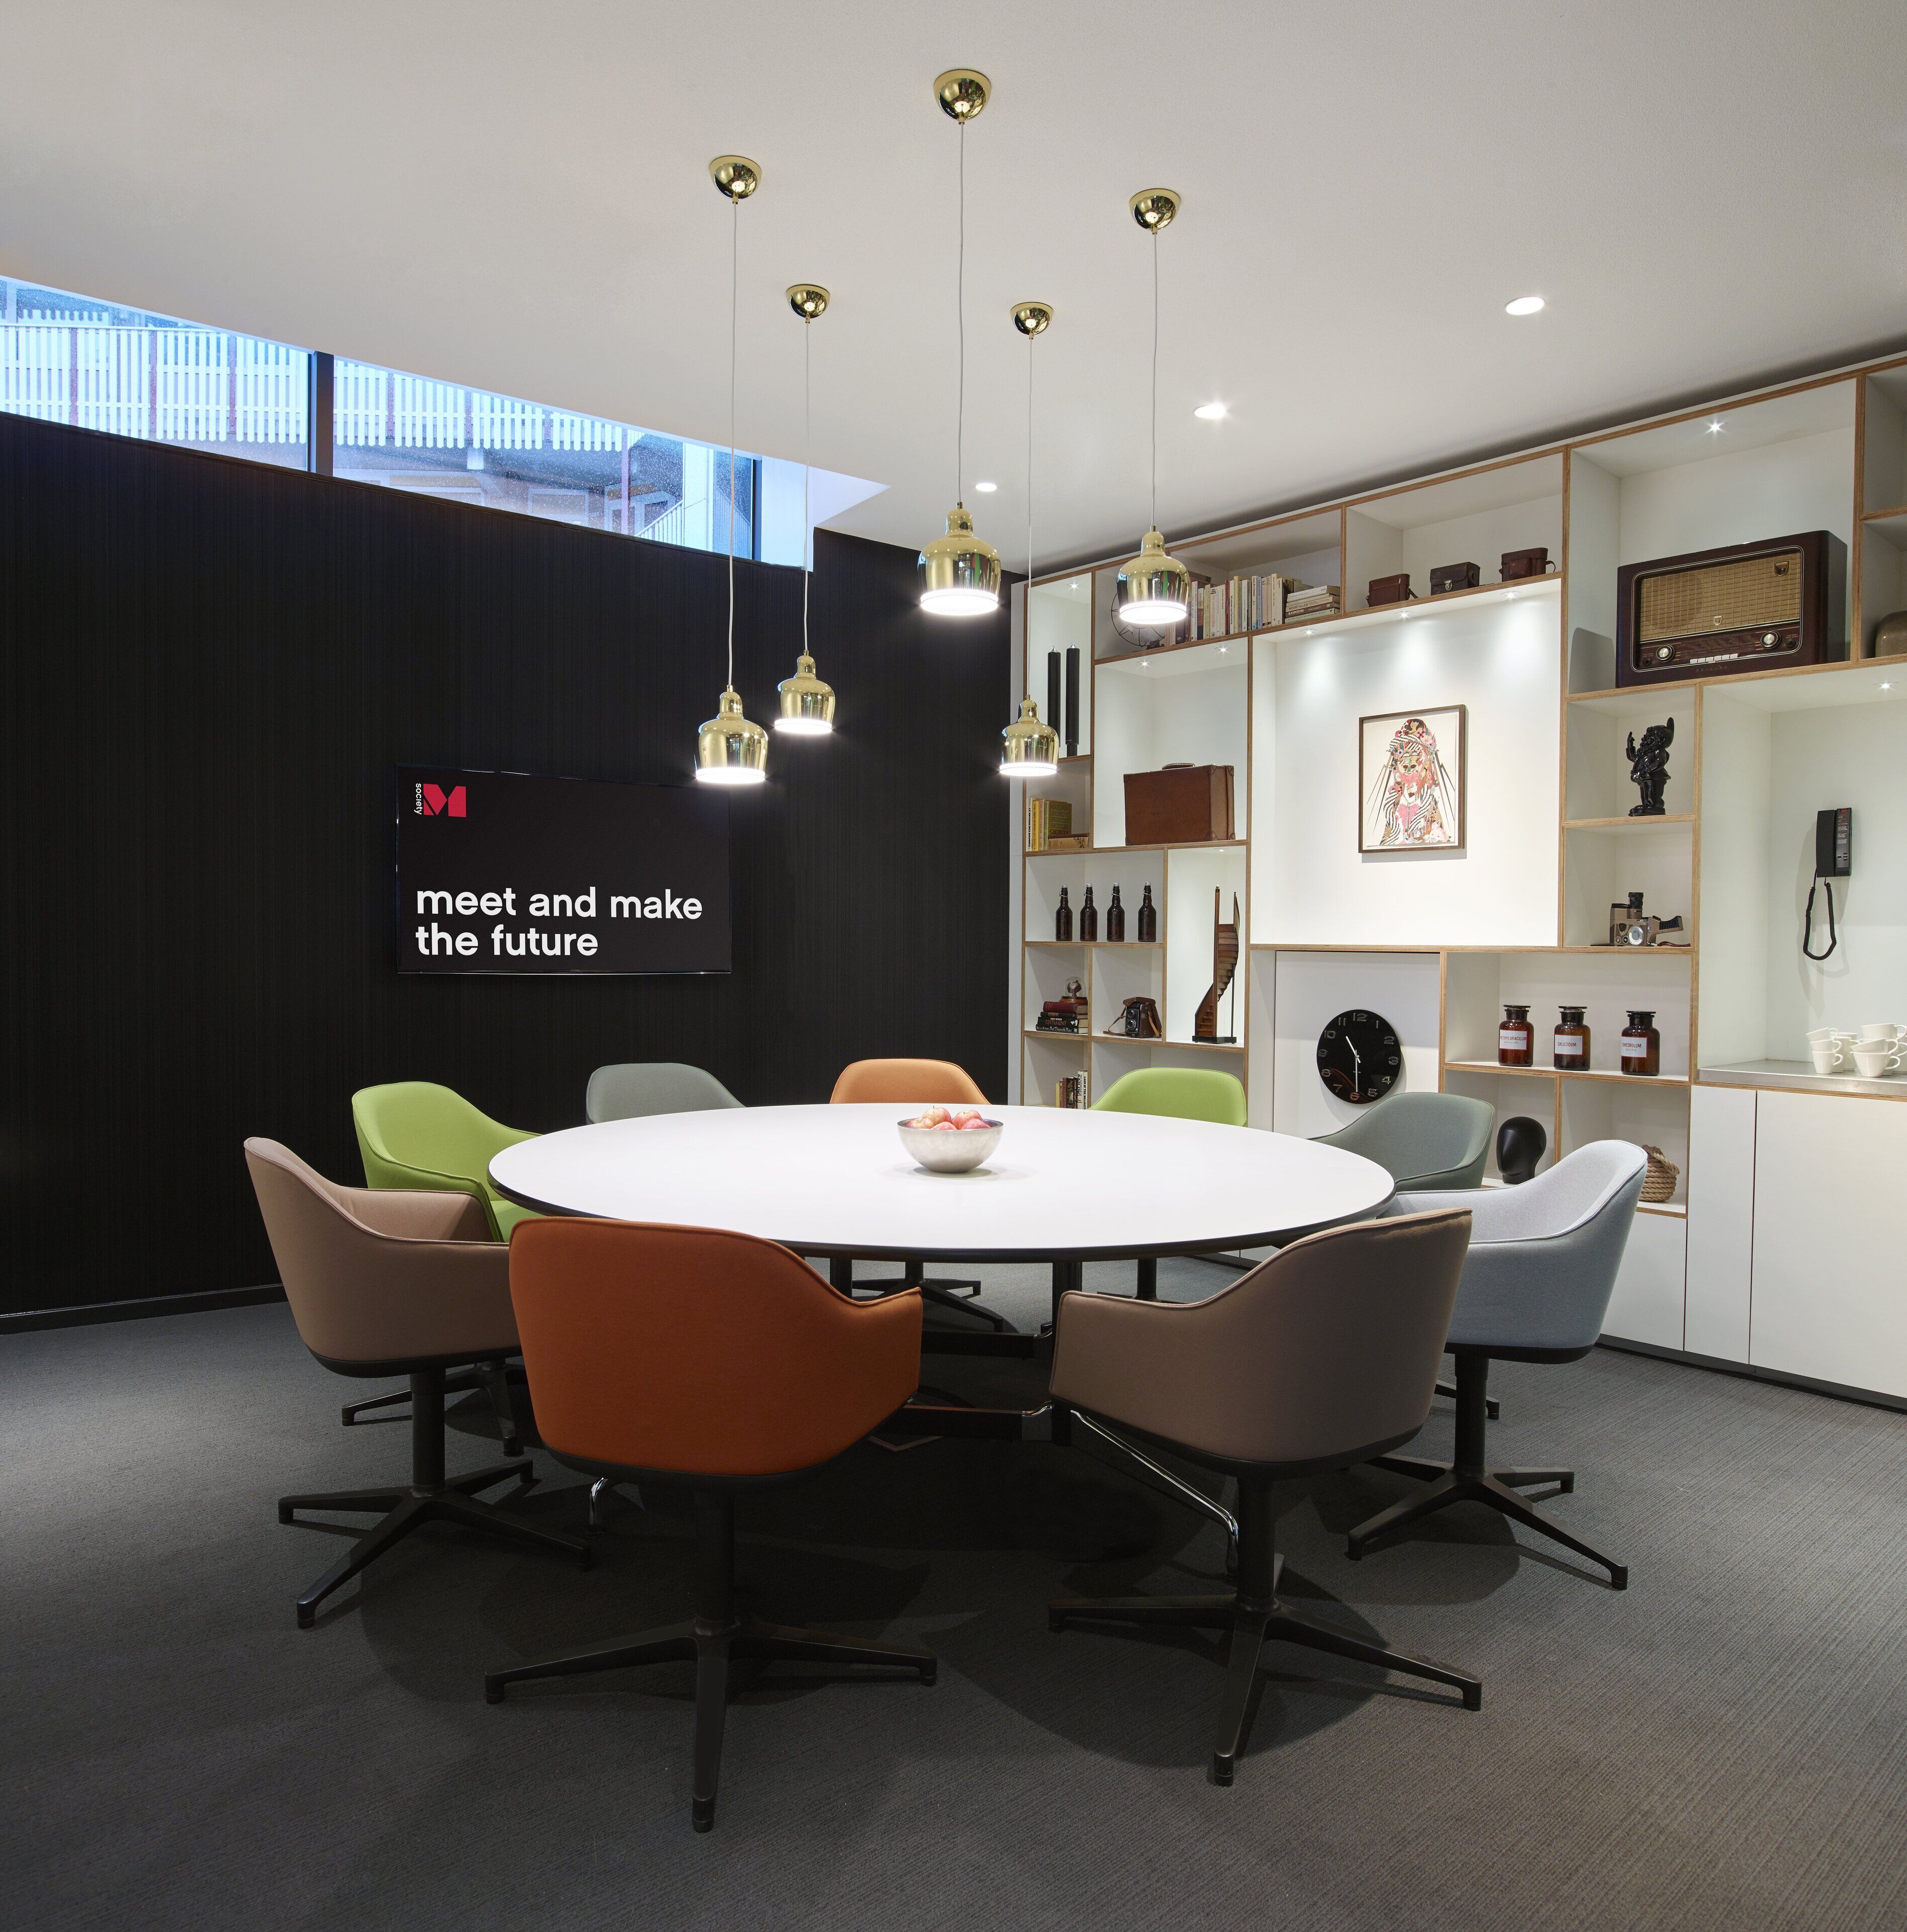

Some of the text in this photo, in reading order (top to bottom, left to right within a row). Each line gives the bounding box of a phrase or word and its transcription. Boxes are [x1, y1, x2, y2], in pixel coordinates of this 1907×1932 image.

[414, 783, 423, 815] society
[417, 887, 703, 919] meet and make
[415, 923, 599, 956] the future
[1338, 1017, 1346, 1026] 11
[1353, 1013, 1368, 1022] 12
[1376, 1020, 1379, 1028] 1
[1324, 1030, 1336, 1039] 10
[1384, 1036, 1395, 1044] 2
[1318, 1049, 1328, 1057] 9
[1388, 1057, 1398, 1065] 3
[1321, 1069, 1331, 1077] 8
[1382, 1076, 1391, 1084] 4
[1333, 1084, 1343, 1092] 7
[1368, 1088, 1378, 1097] 5
[1350, 1092, 1360, 1101] 6
